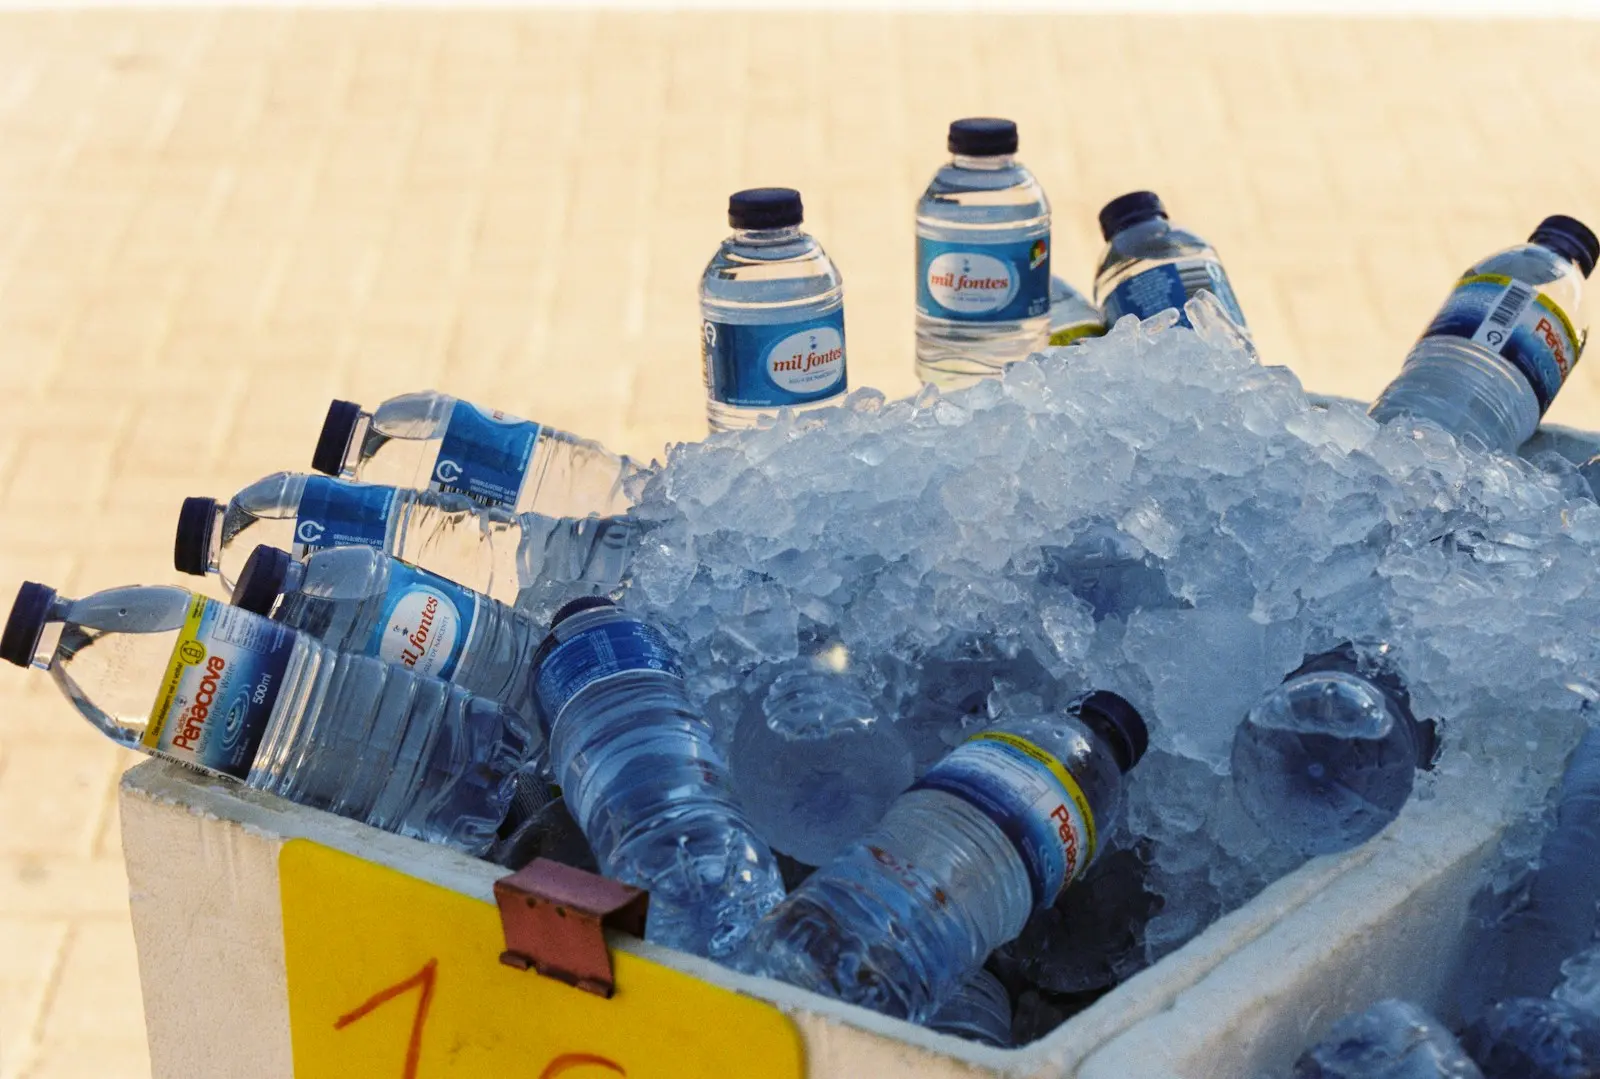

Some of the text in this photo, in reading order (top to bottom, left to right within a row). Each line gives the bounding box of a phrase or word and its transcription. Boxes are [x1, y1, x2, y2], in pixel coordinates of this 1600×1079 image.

[931, 271, 1009, 292] mil fontes
[773, 347, 843, 373] mil fontes
[399, 596, 438, 670] il fontes
[220, 661, 237, 689] Water
[172, 655, 226, 752] Penacova
